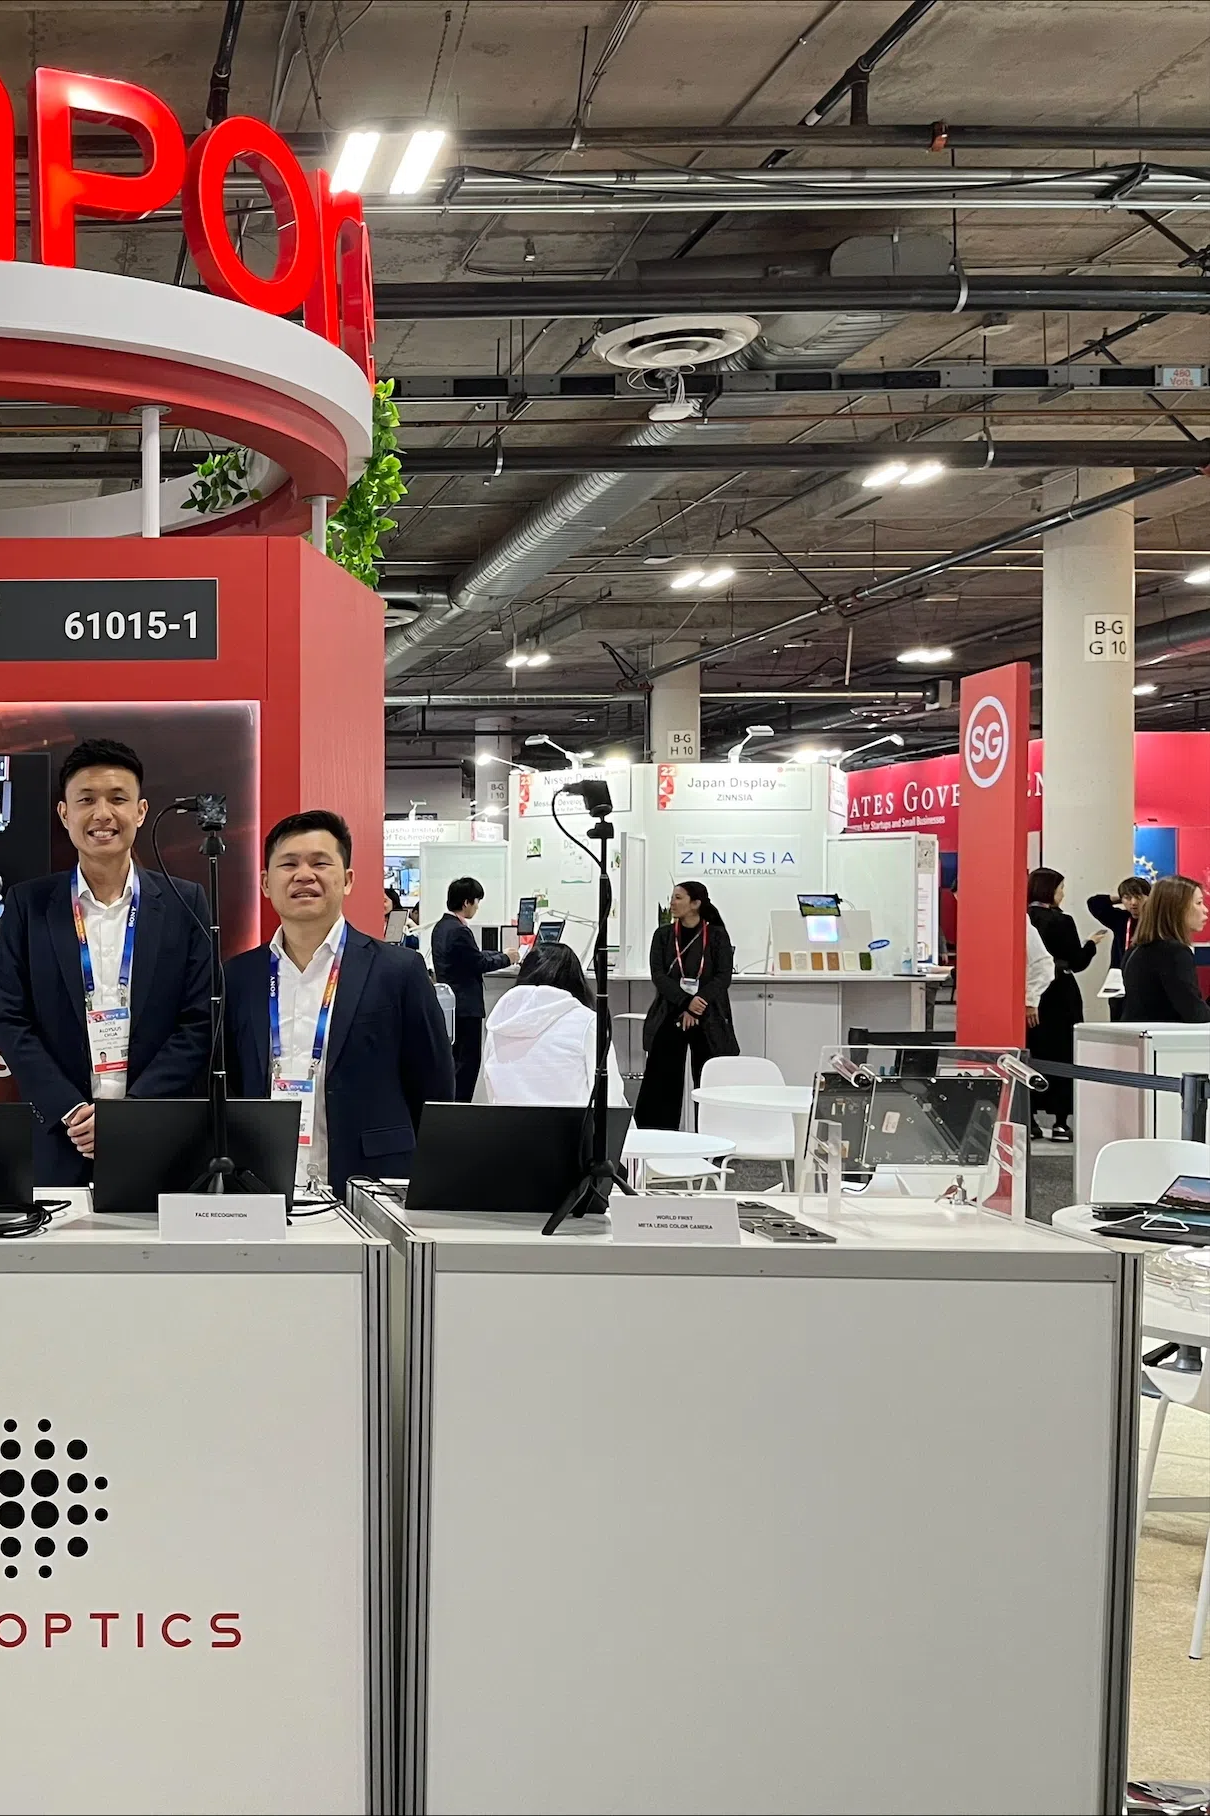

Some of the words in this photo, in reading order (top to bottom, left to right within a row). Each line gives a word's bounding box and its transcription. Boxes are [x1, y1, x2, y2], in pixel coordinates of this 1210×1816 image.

[64, 610, 198, 640] 61015-1
[1095, 620, 1123, 635] B-G
[1089, 641, 1103, 655] G
[1111, 641, 1126, 655] 10
[673, 734, 691, 743] B-G
[971, 722, 1003, 763] SG
[683, 747, 693, 756] 10
[661, 767, 676, 776] 22
[687, 778, 725, 790] Japan
[730, 778, 777, 790] Display
[870, 819, 891, 831] Startups
[891, 818, 901, 828] and
[901, 816, 915, 827] Small
[916, 815, 946, 826] Businesses
[680, 851, 796, 864] ZINNSIA
[269, 976, 277, 997] SONY
